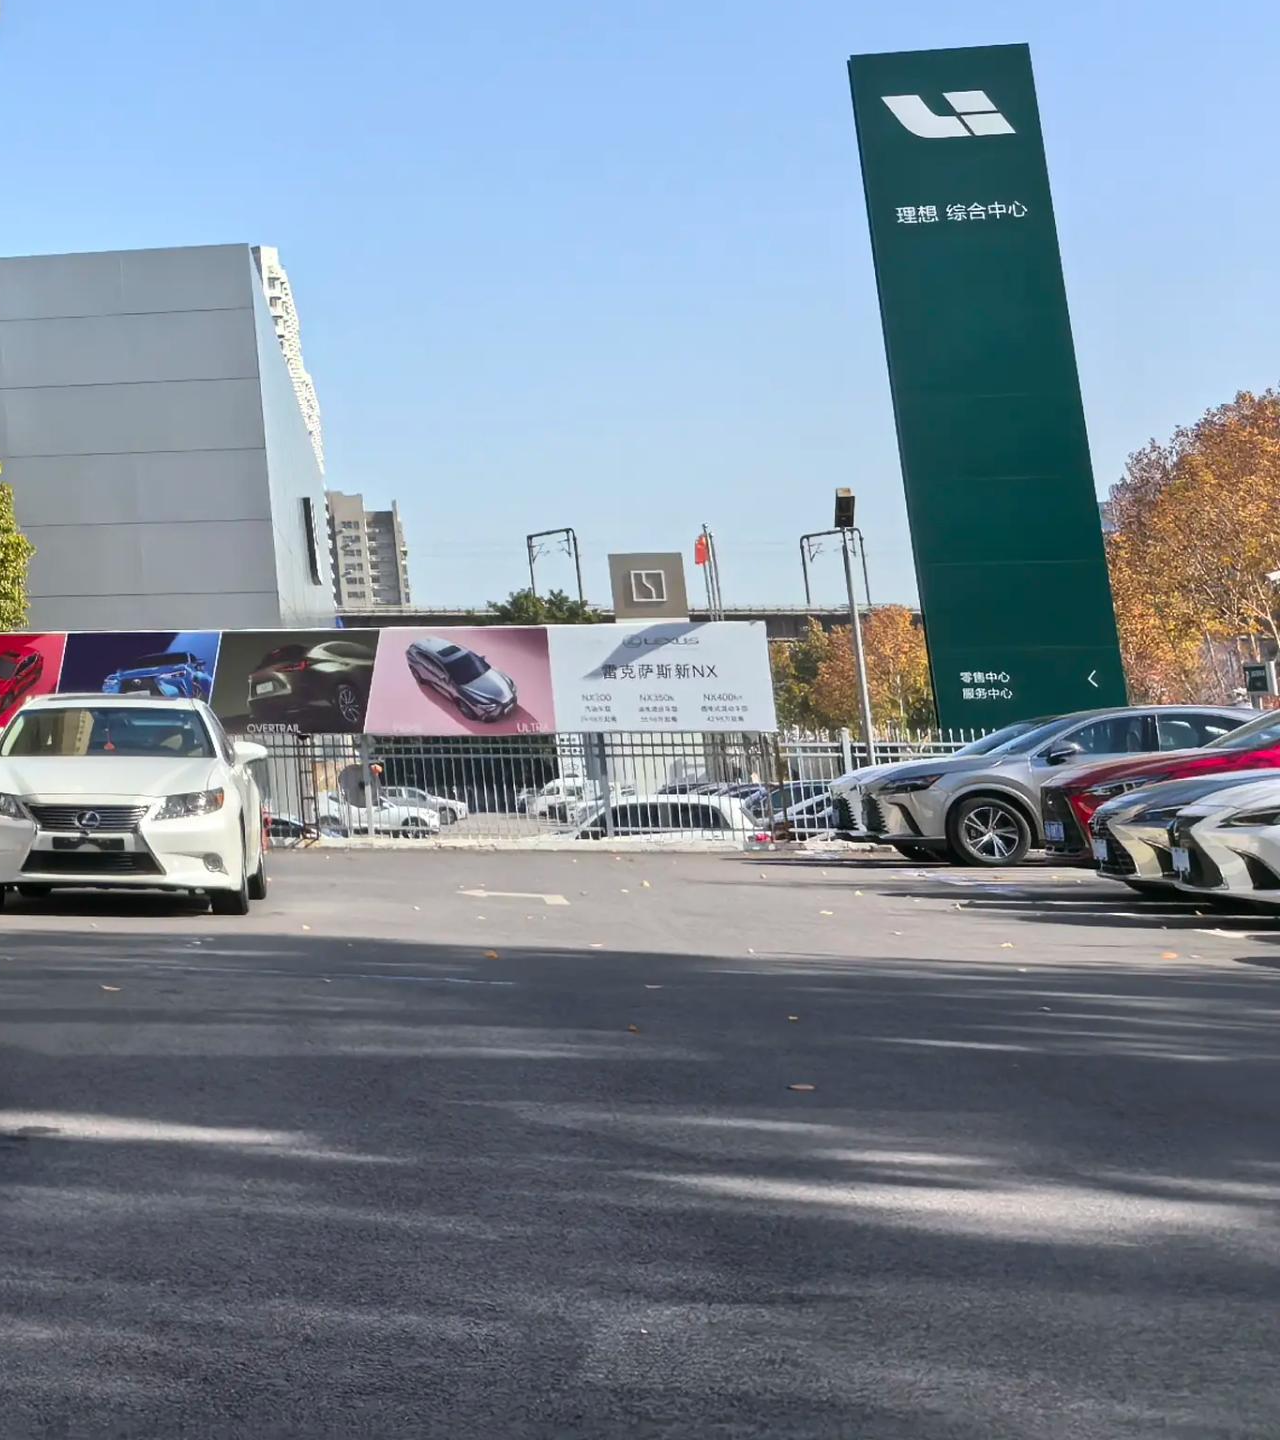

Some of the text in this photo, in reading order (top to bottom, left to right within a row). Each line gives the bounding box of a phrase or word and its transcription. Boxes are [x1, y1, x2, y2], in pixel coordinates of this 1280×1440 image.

[895, 200, 1028, 225] 理想 综合中心
[643, 636, 700, 646] LEXUS
[602, 664, 719, 680] 雷克萨斯新NX
[960, 671, 1010, 684] 零售中心
[962, 687, 1013, 700] 服务中心
